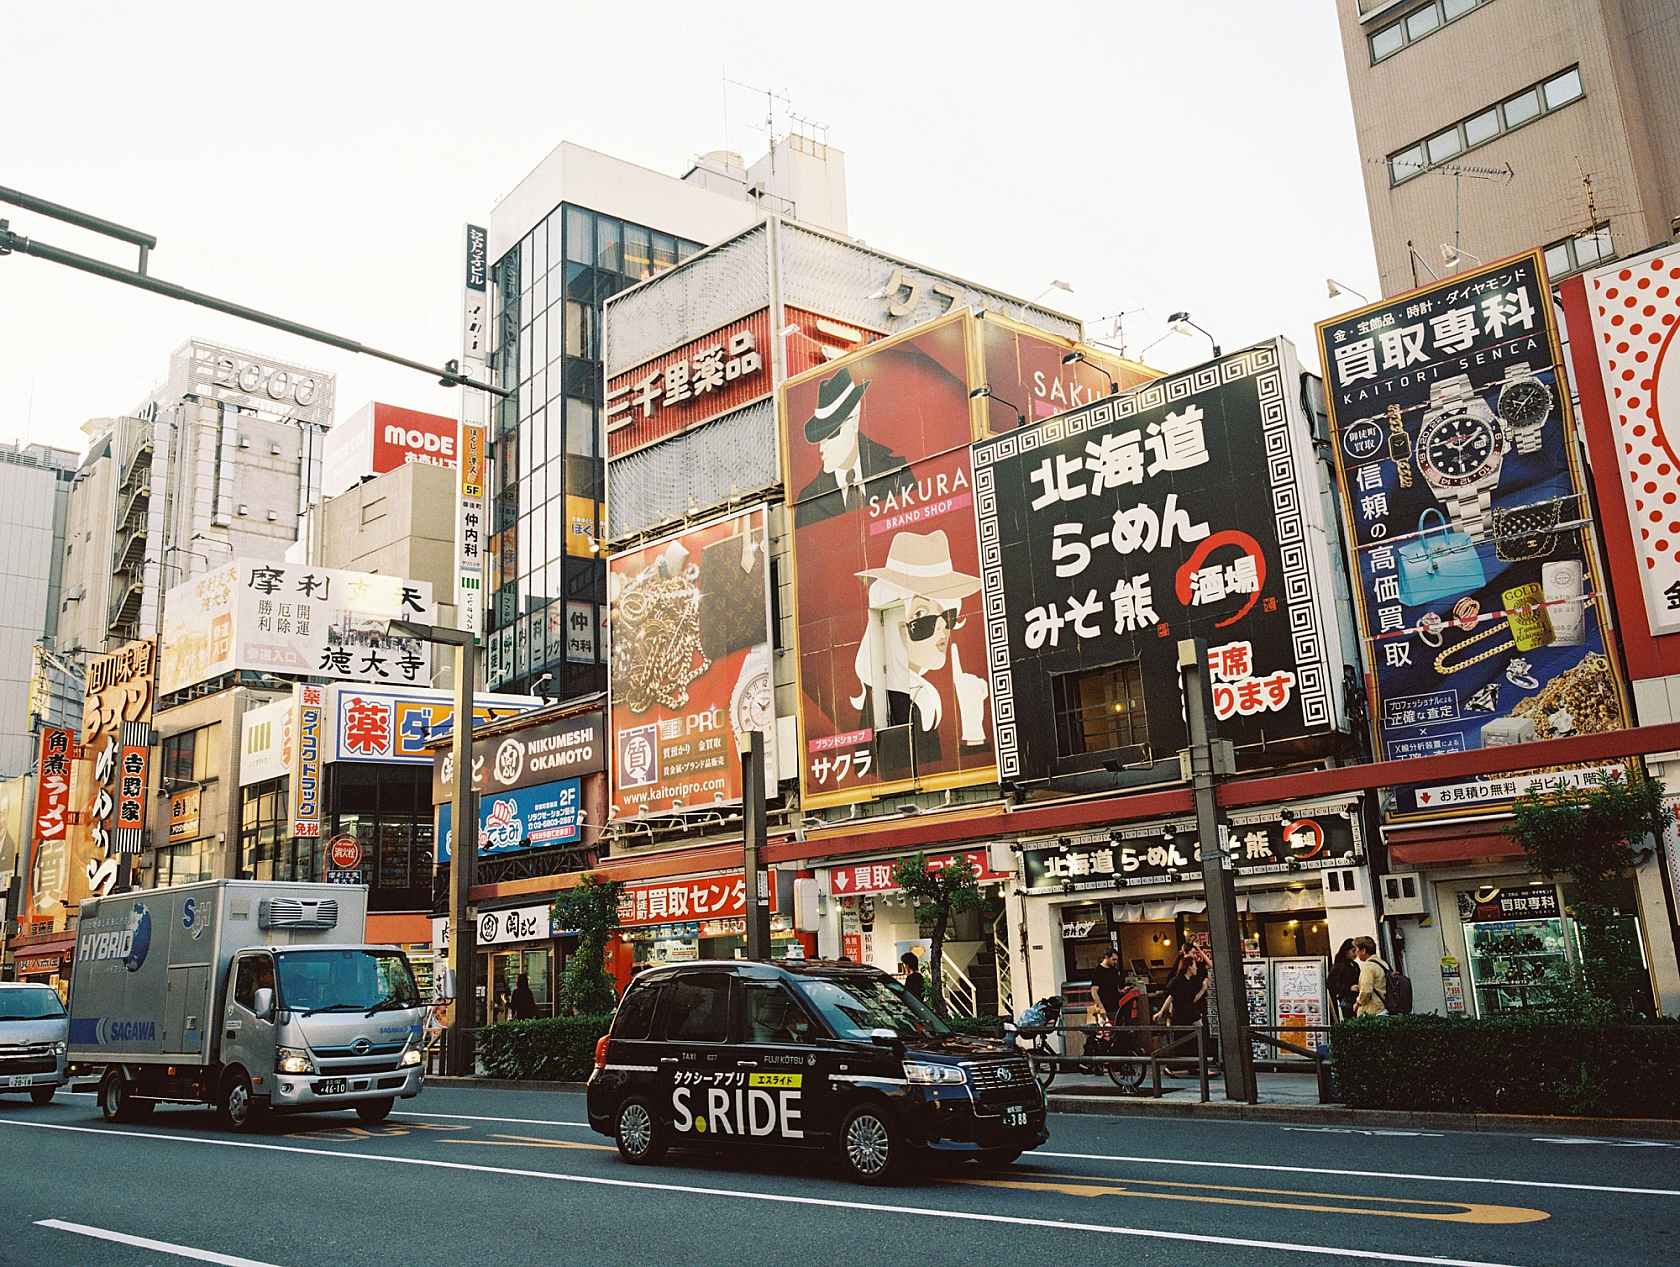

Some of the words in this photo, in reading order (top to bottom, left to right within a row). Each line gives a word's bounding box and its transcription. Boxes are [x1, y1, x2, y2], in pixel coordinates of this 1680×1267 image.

[1334, 286, 1535, 387] 買取専科
[606, 330, 762, 433] 三千里薬品
[1343, 370, 1439, 405] KAITORI
[1459, 338, 1538, 370] SENCA
[385, 425, 454, 456] MODE
[1030, 404, 1209, 513] 北海道
[466, 485, 480, 495] 5F
[869, 467, 969, 518] SAKURA
[886, 511, 920, 529] BRAND
[924, 499, 953, 518] SHOP
[464, 513, 479, 558] 仲内科
[1051, 493, 1210, 579] らーめん
[1189, 554, 1260, 607] 酒場
[1356, 463, 1413, 668] 信頼の高価買取
[248, 565, 426, 613] 摩利天
[258, 600, 272, 632] 勝利
[296, 604, 311, 636] 開運
[570, 611, 589, 632] 仲
[1025, 572, 1161, 650] みそ熊
[569, 638, 592, 654] 内科
[303, 686, 321, 705] 薬
[1214, 676, 1290, 715] ります
[345, 697, 391, 755] 薬
[1391, 705, 1454, 726] 正確な査定
[528, 727, 594, 755] NIKUMESHI
[300, 710, 320, 817] ダイコクドラッグ
[529, 746, 593, 772] OKAMOTO
[811, 750, 872, 785] サクラ
[39, 730, 70, 837] 角煮ラーメン
[559, 788, 576, 806] 2F
[623, 779, 725, 805] www.kaitoripro.com
[1440, 781, 1517, 801] お見積り無料
[295, 822, 320, 838] 免税
[1044, 848, 1115, 878] 北海道
[1121, 844, 1189, 872] らーめん
[649, 879, 747, 919] 買取センタ
[1501, 896, 1555, 912] 買取専科
[79, 930, 133, 961] HYBRID
[111, 1021, 156, 1041] SAGAWA
[682, 1052, 697, 1060] TAXI
[674, 1071, 745, 1086] タクシーアプリ
[758, 1075, 793, 1085] エスライド
[672, 1086, 804, 1139] S.RIDE
